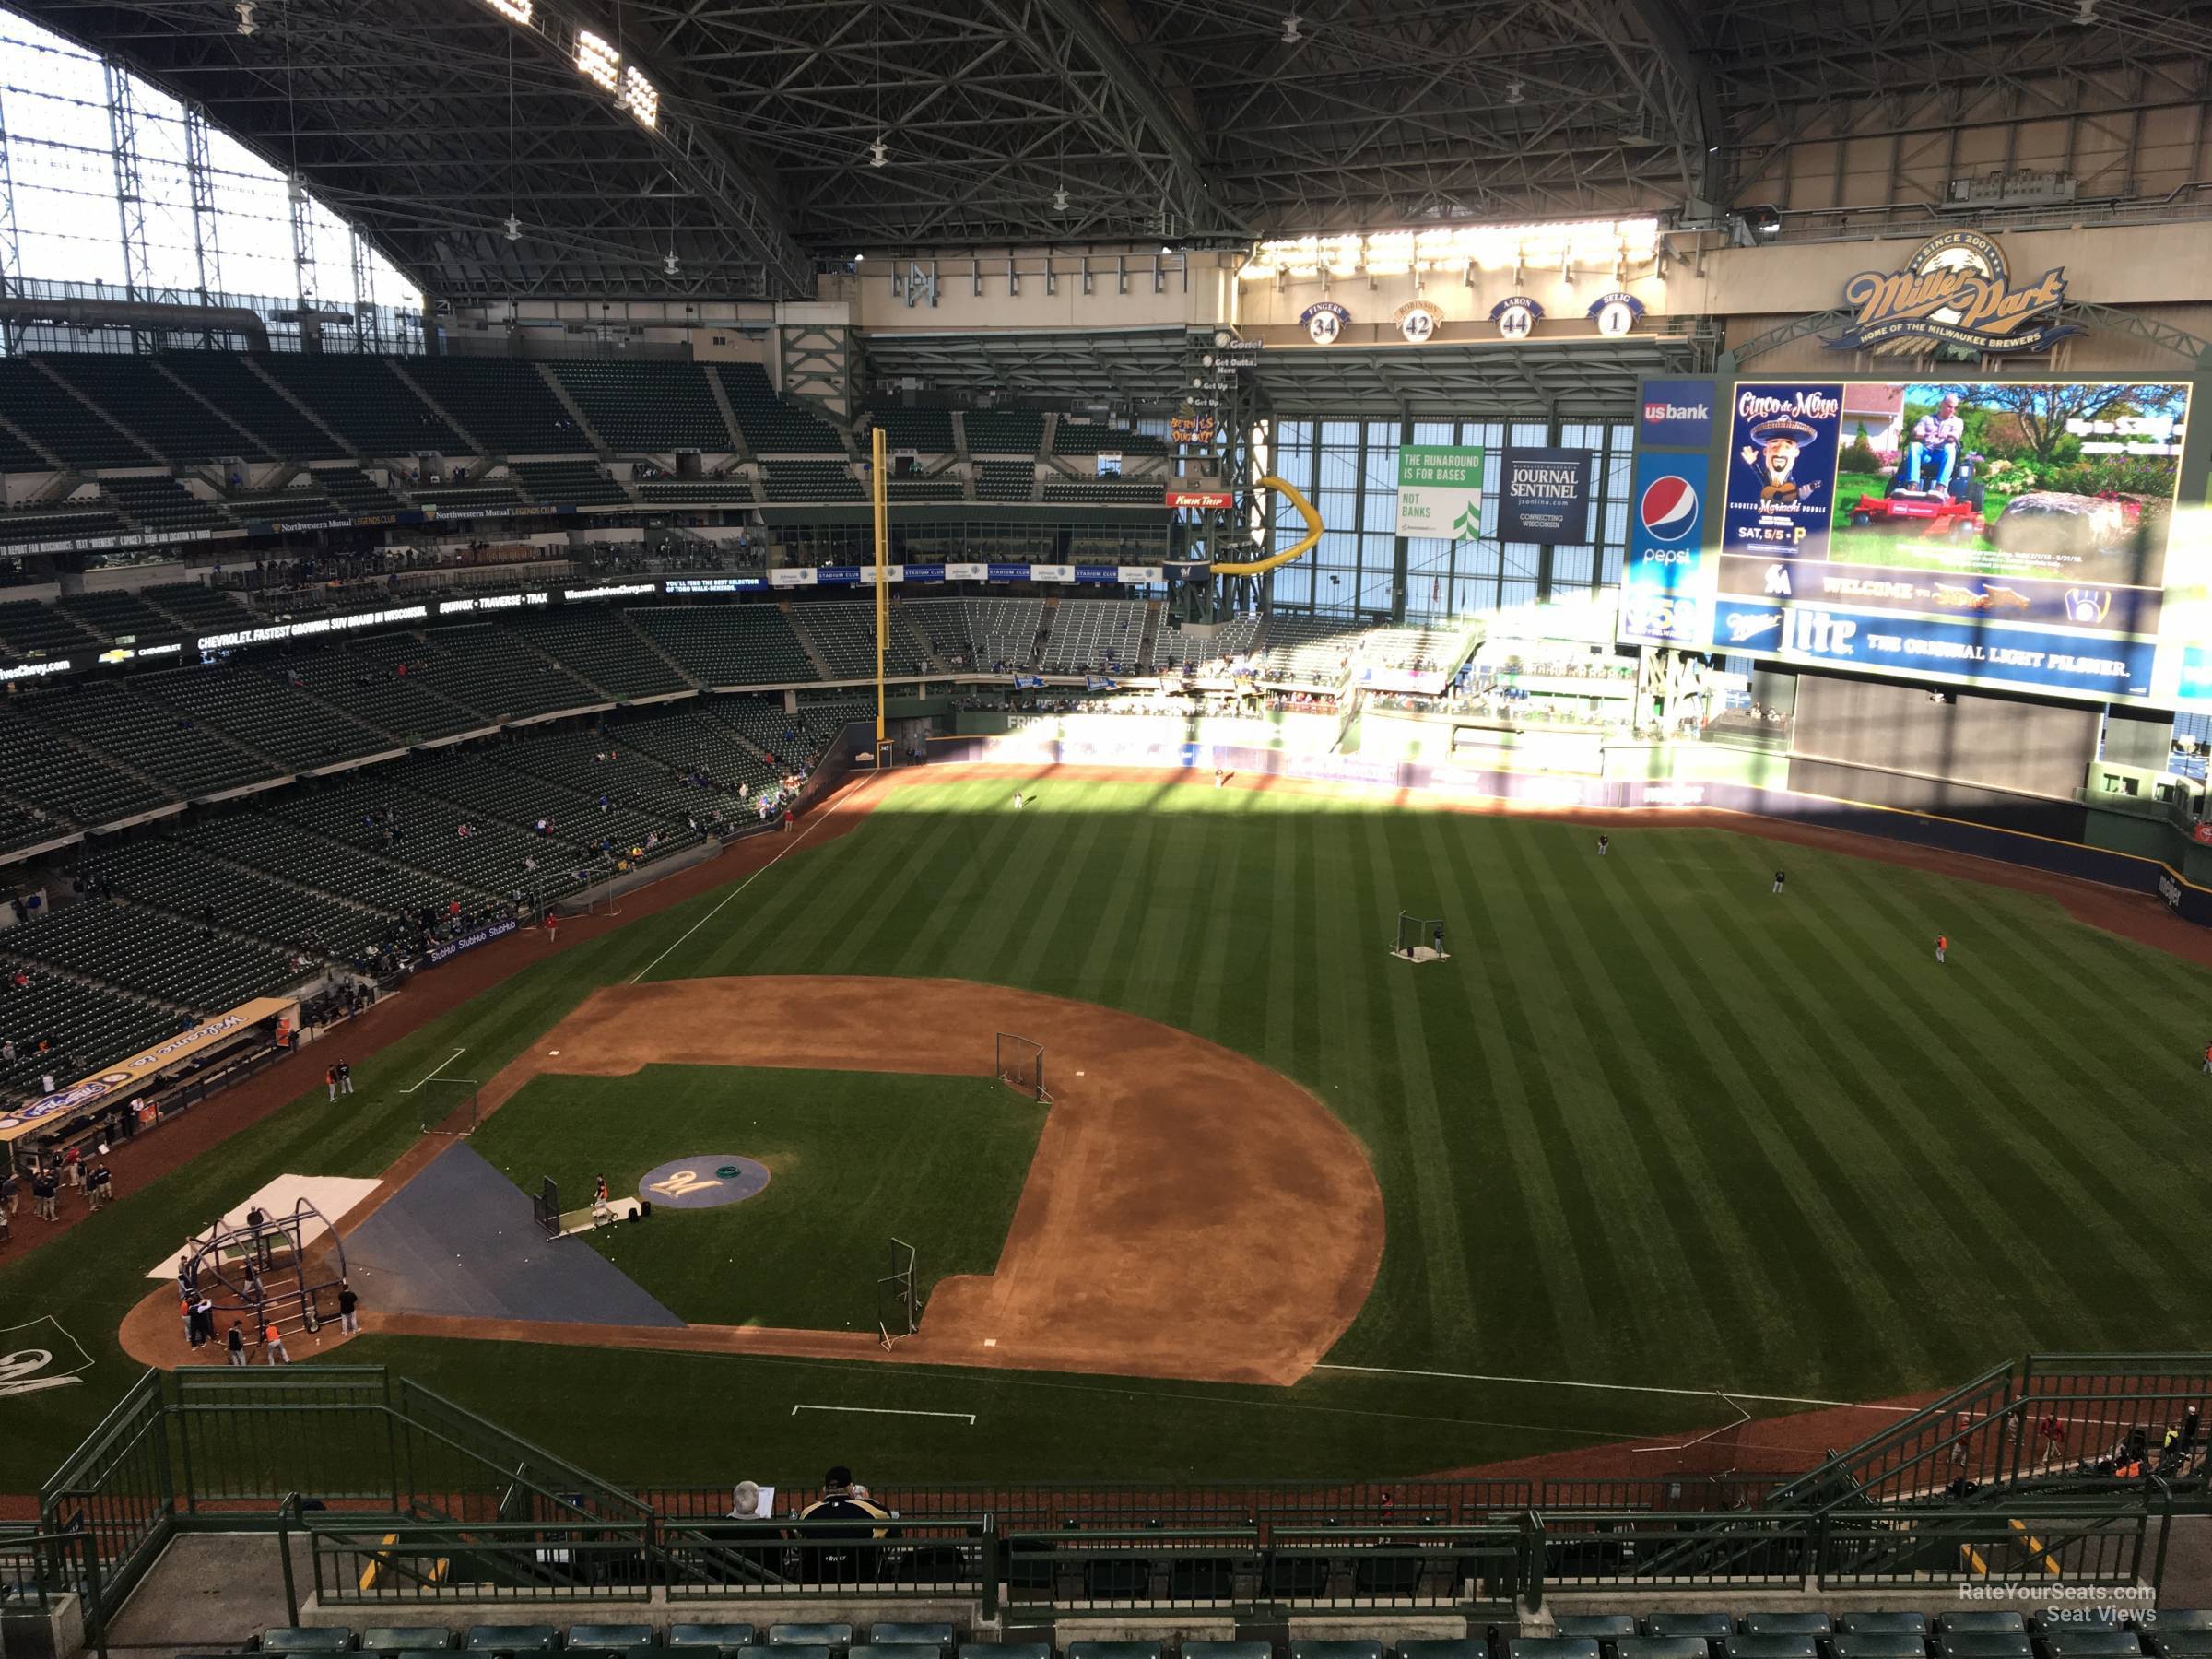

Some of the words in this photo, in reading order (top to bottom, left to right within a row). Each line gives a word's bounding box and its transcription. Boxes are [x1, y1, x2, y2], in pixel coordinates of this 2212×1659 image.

[1924, 233, 1960, 257] SINCE
[1965, 235, 1991, 253] 2001
[1503, 297, 1532, 308] AARON
[1603, 293, 1630, 303] SELIG
[1846, 267, 1976, 325] Miller
[1946, 271, 2062, 333] Park
[1309, 303, 1343, 315] FINGERS
[1399, 300, 1438, 313] ROBINSON
[1313, 318, 1336, 337] 34
[1406, 316, 1430, 335] 42
[1503, 313, 1527, 334] 44
[1610, 312, 1620, 332] 1
[1860, 326, 1888, 343] HOME
[1889, 324, 1903, 333] OF
[1906, 323, 1925, 332] THE
[1928, 324, 1986, 347] MILWAUKEE
[1988, 333, 2041, 347] BREWERS
[1230, 339, 1262, 349] Gone!
[1215, 359, 1230, 367] Get
[1208, 399, 1219, 407] Up
[1739, 391, 1781, 422] Cinco
[1780, 400, 1793, 413] de
[1792, 391, 1838, 419] Mayo
[1172, 430, 1215, 443] DUGOUT
[1405, 453, 1422, 466] THE
[1424, 454, 1479, 467] RUNAROUND
[1404, 468, 1414, 479] IS
[1416, 468, 1434, 480] FOR
[1436, 469, 1466, 481] BASES
[1512, 468, 1579, 485] JOURNAL
[1402, 493, 1420, 504] NOT
[1510, 483, 1578, 499] SENTINEL
[1201, 496, 1223, 506] TRIP
[1758, 499, 1802, 514] Mariachi
[435, 509, 484, 520] Northwestern
[485, 508, 510, 516] Mutual
[512, 507, 540, 515] LEGENDS
[540, 506, 557, 514] CLUB
[1402, 506, 1431, 518] BANKS
[1519, 512, 1564, 522] CONNECTING
[281, 522, 328, 532] Northwestern
[328, 518, 353, 527] Mutual
[354, 516, 381, 525] LEGENDS
[381, 514, 396, 524] CLUB
[1523, 520, 1560, 528] WISCONSIN
[1738, 526, 1763, 540] SAT,
[1764, 529, 1784, 540] 5/5
[29, 543, 39, 553] FAN
[1643, 548, 1691, 567] pepsi
[1823, 576, 1914, 599] WELCOME
[439, 599, 474, 614] EQUINOX
[479, 594, 522, 609] TRAVERSE
[526, 592, 548, 605] TRAX
[197, 630, 253, 650] CHEVROLET.
[253, 624, 291, 641] FASTEST
[291, 619, 330, 636] GROWING
[330, 617, 347, 629] SUV
[347, 613, 374, 628] BRAND
[374, 611, 384, 623] IN
[384, 605, 428, 622] WISCONSIN.
[138, 643, 182, 656] CHEVROLET
[1867, 633, 1902, 653] THE
[1903, 638, 1986, 662] ORIGINAL
[1989, 647, 2047, 669] LIGHT
[2159, 875, 2182, 907] meijer
[488, 920, 516, 937] StubHub
[458, 932, 487, 949] StubHub
[431, 944, 456, 962] StubHub
[157, 1015, 250, 1054] Welcome
